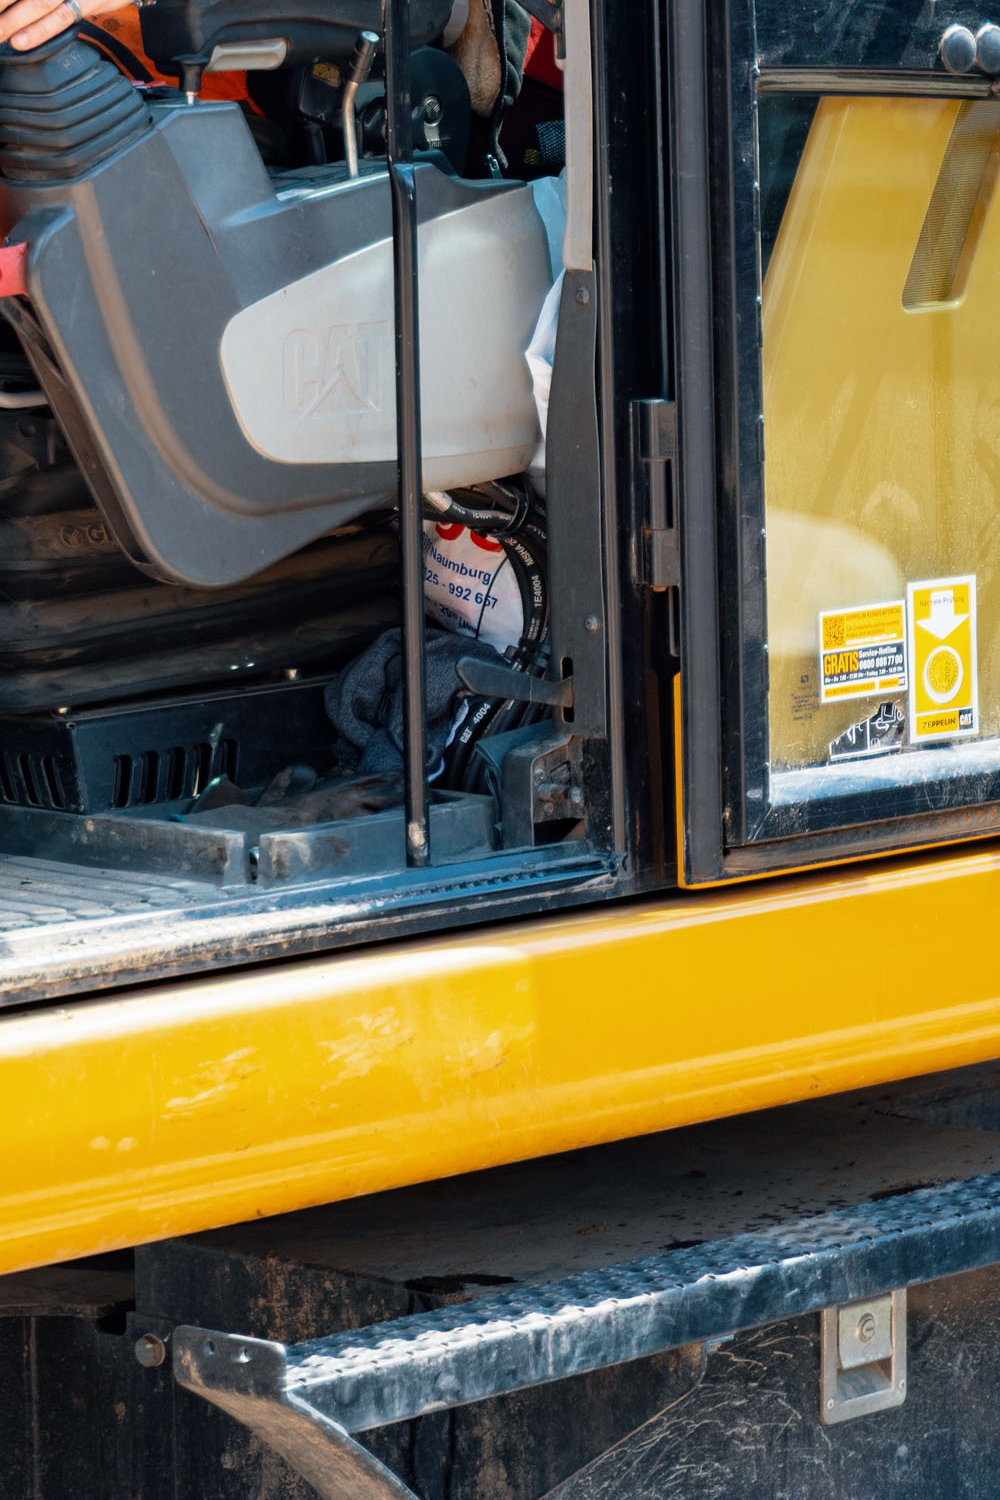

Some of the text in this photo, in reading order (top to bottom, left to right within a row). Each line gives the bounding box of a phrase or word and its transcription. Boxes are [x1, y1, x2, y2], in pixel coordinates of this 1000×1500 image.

[282, 319, 391, 421] CAT
[430, 547, 491, 585] Naumburg
[448, 583, 472, 601] 992
[531, 575, 543, 608] 1E4004
[824, 651, 859, 676] GRATIS
[859, 646, 897, 659] Service-Hotline
[460, 703, 491, 743] CAT 4004
[922, 713, 973, 729] ZEPPELIN CAT
